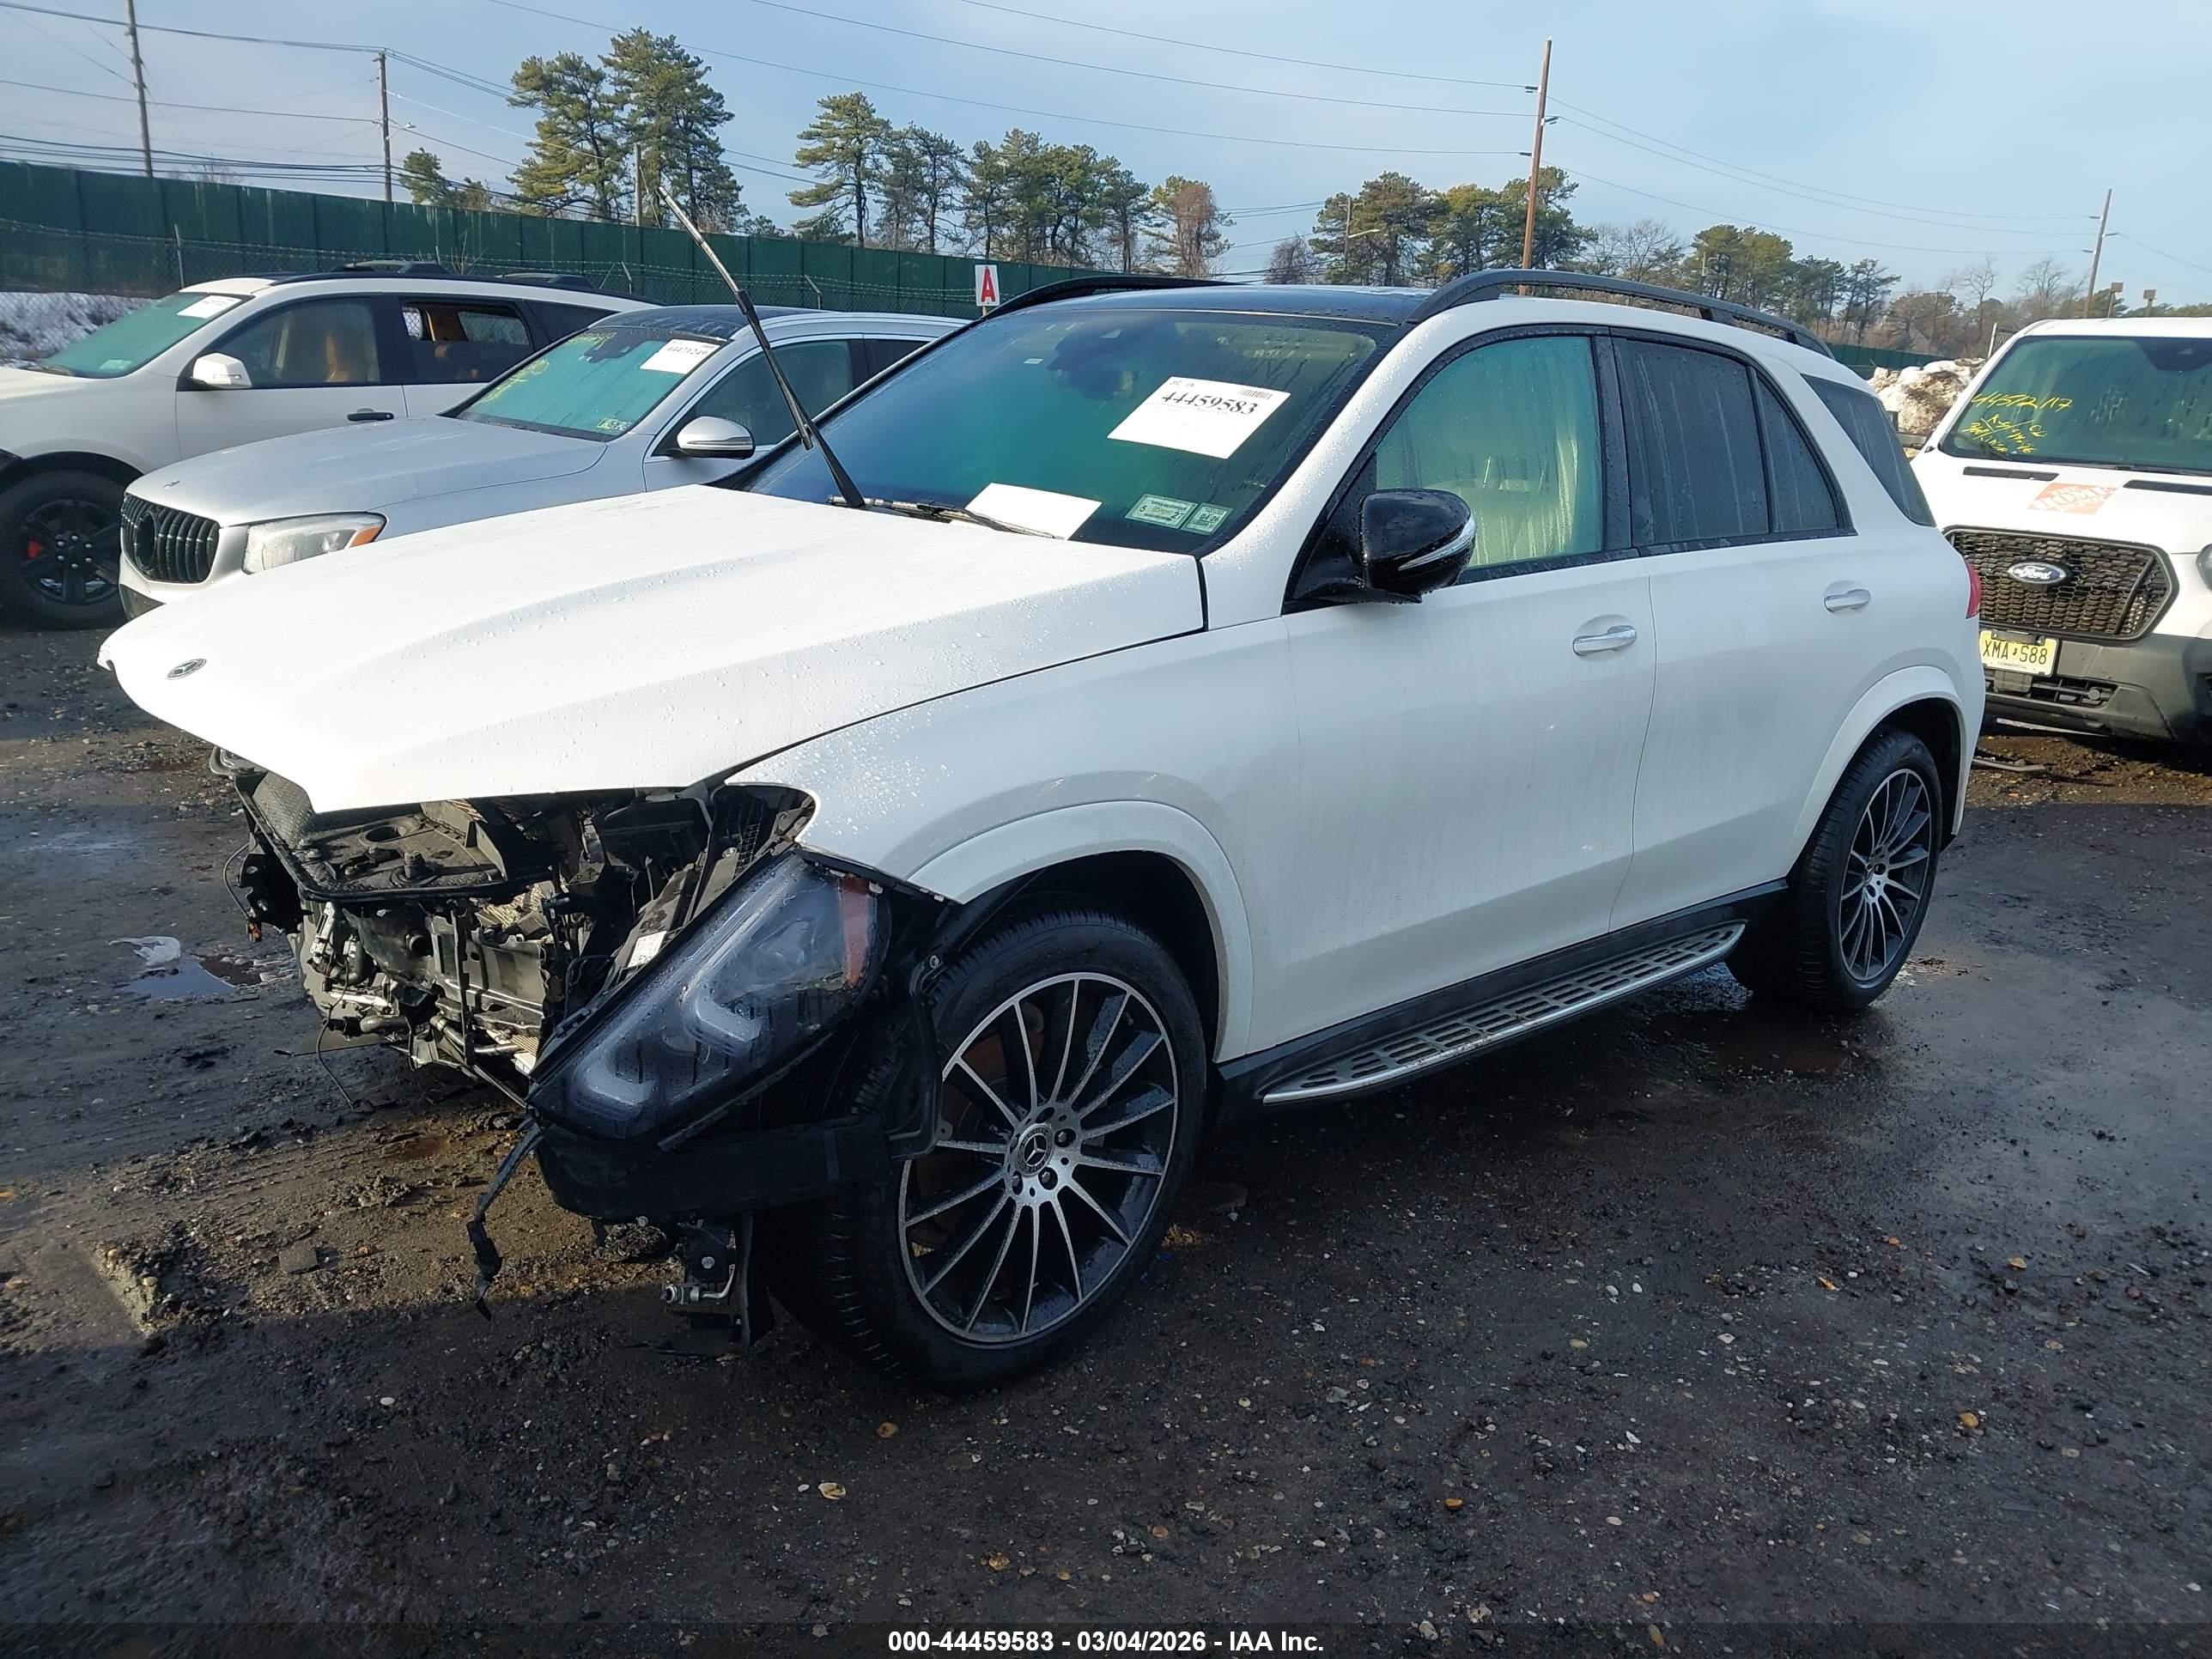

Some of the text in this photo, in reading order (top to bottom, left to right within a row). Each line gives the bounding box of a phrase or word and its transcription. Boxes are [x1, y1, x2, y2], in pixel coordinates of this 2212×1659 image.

[981, 267, 996, 302] A
[1162, 391, 1259, 415] 44459583
[2014, 565, 2052, 580] Ford
[1983, 640, 2048, 665] XMA 588
